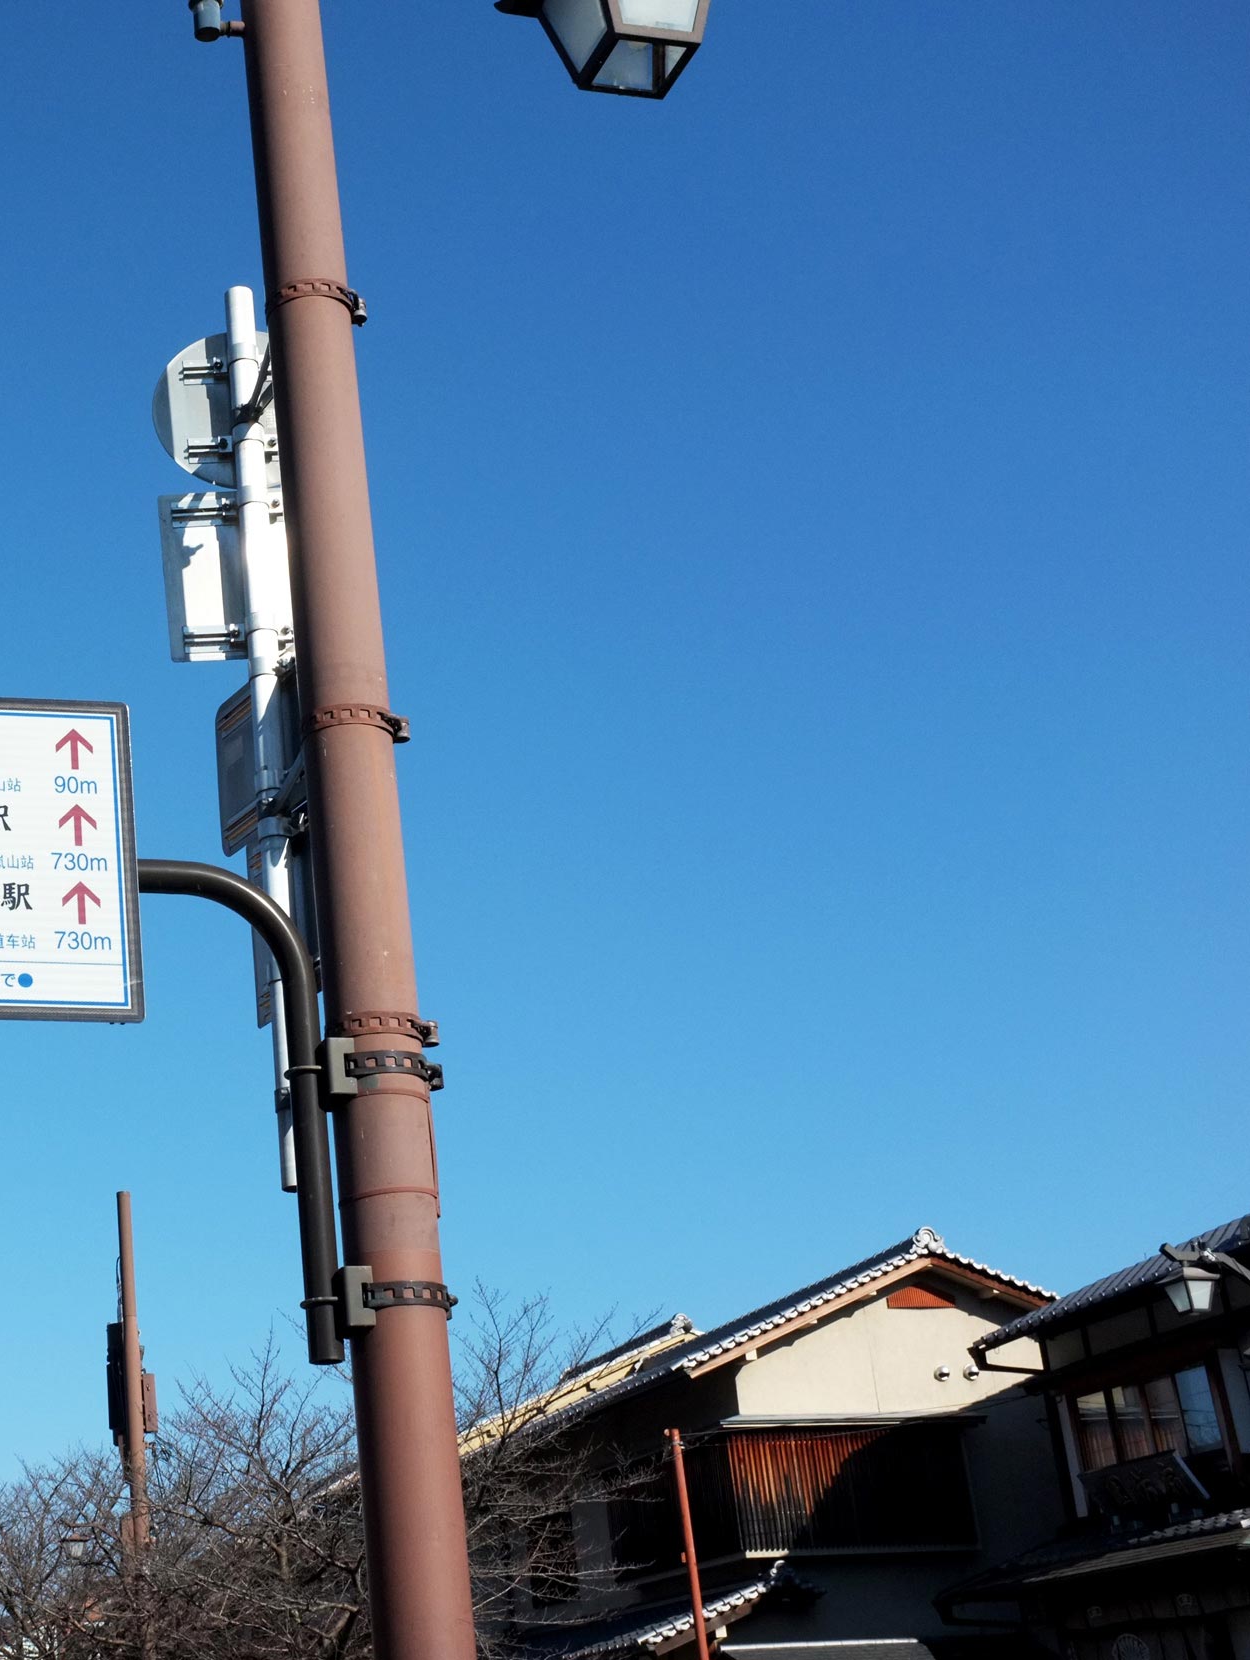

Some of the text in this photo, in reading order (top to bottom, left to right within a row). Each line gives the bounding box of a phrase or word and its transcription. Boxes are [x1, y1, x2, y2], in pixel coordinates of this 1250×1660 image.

[54, 776, 97, 794] 90m
[51, 852, 107, 871] 730m
[54, 931, 111, 950] 730m
